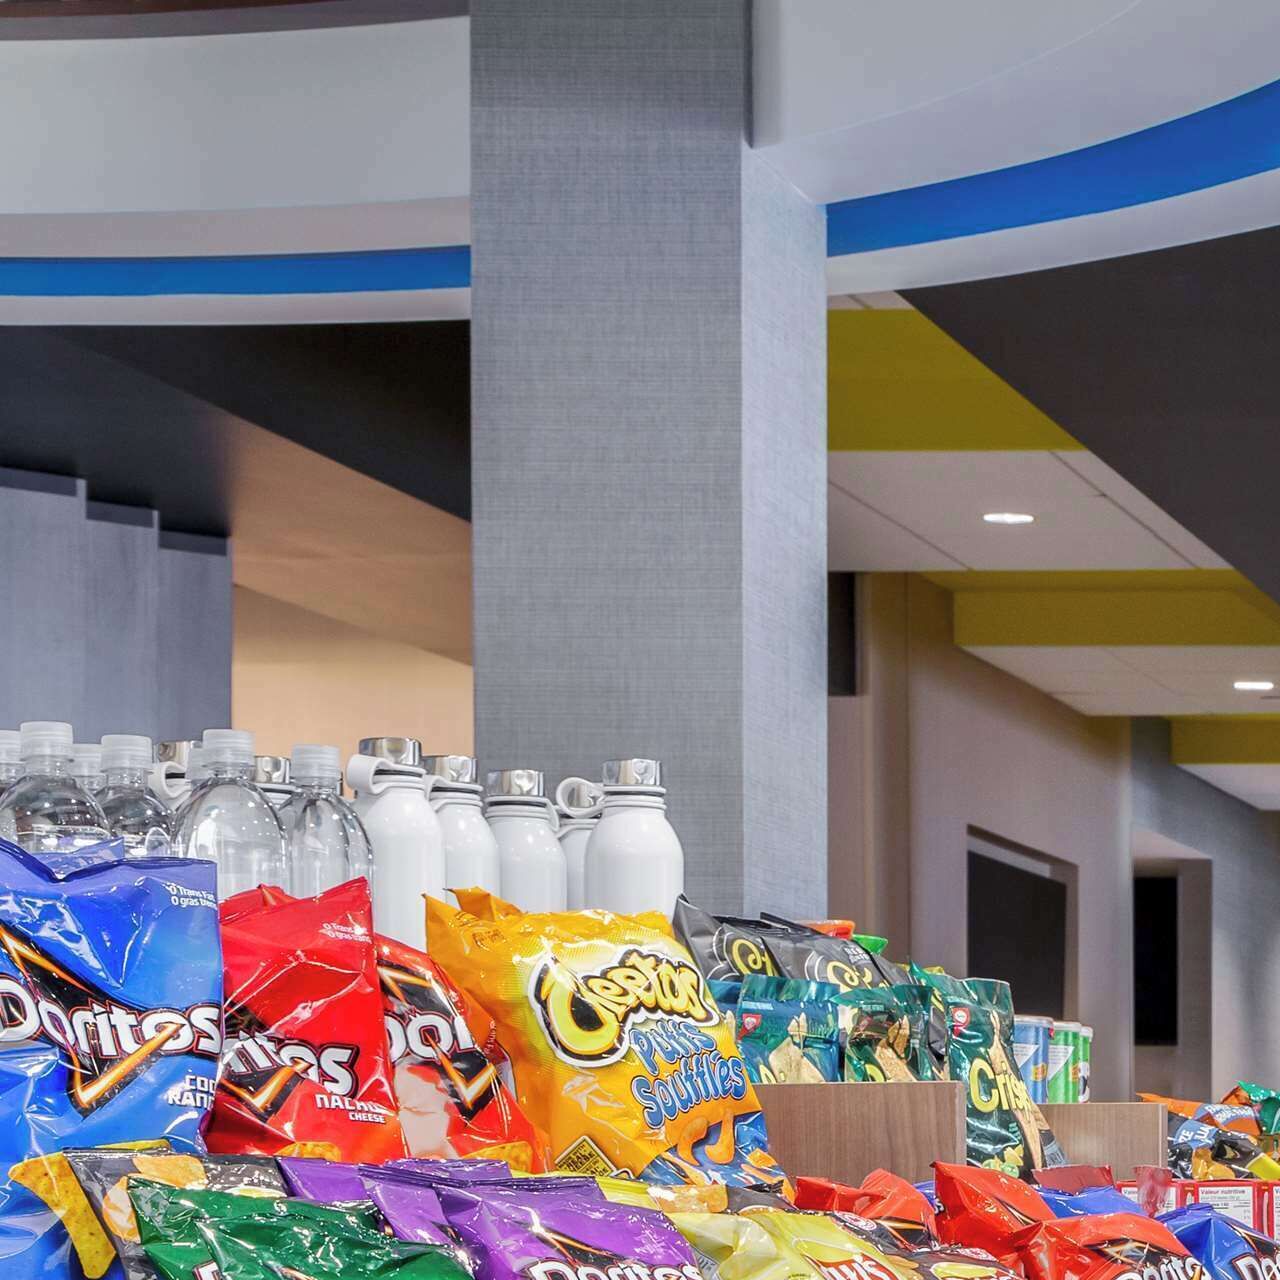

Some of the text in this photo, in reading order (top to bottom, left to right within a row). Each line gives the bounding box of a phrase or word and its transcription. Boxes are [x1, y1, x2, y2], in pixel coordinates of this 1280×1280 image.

[531, 947, 714, 1063] Cheetos
[223, 1030, 354, 1098] ritos
[629, 1020, 717, 1077] Puffs
[169, 1090, 214, 1110] RAN
[183, 1075, 216, 1091] COO
[631, 1053, 748, 1129] Soufflés
[349, 1113, 386, 1125] CHEESE
